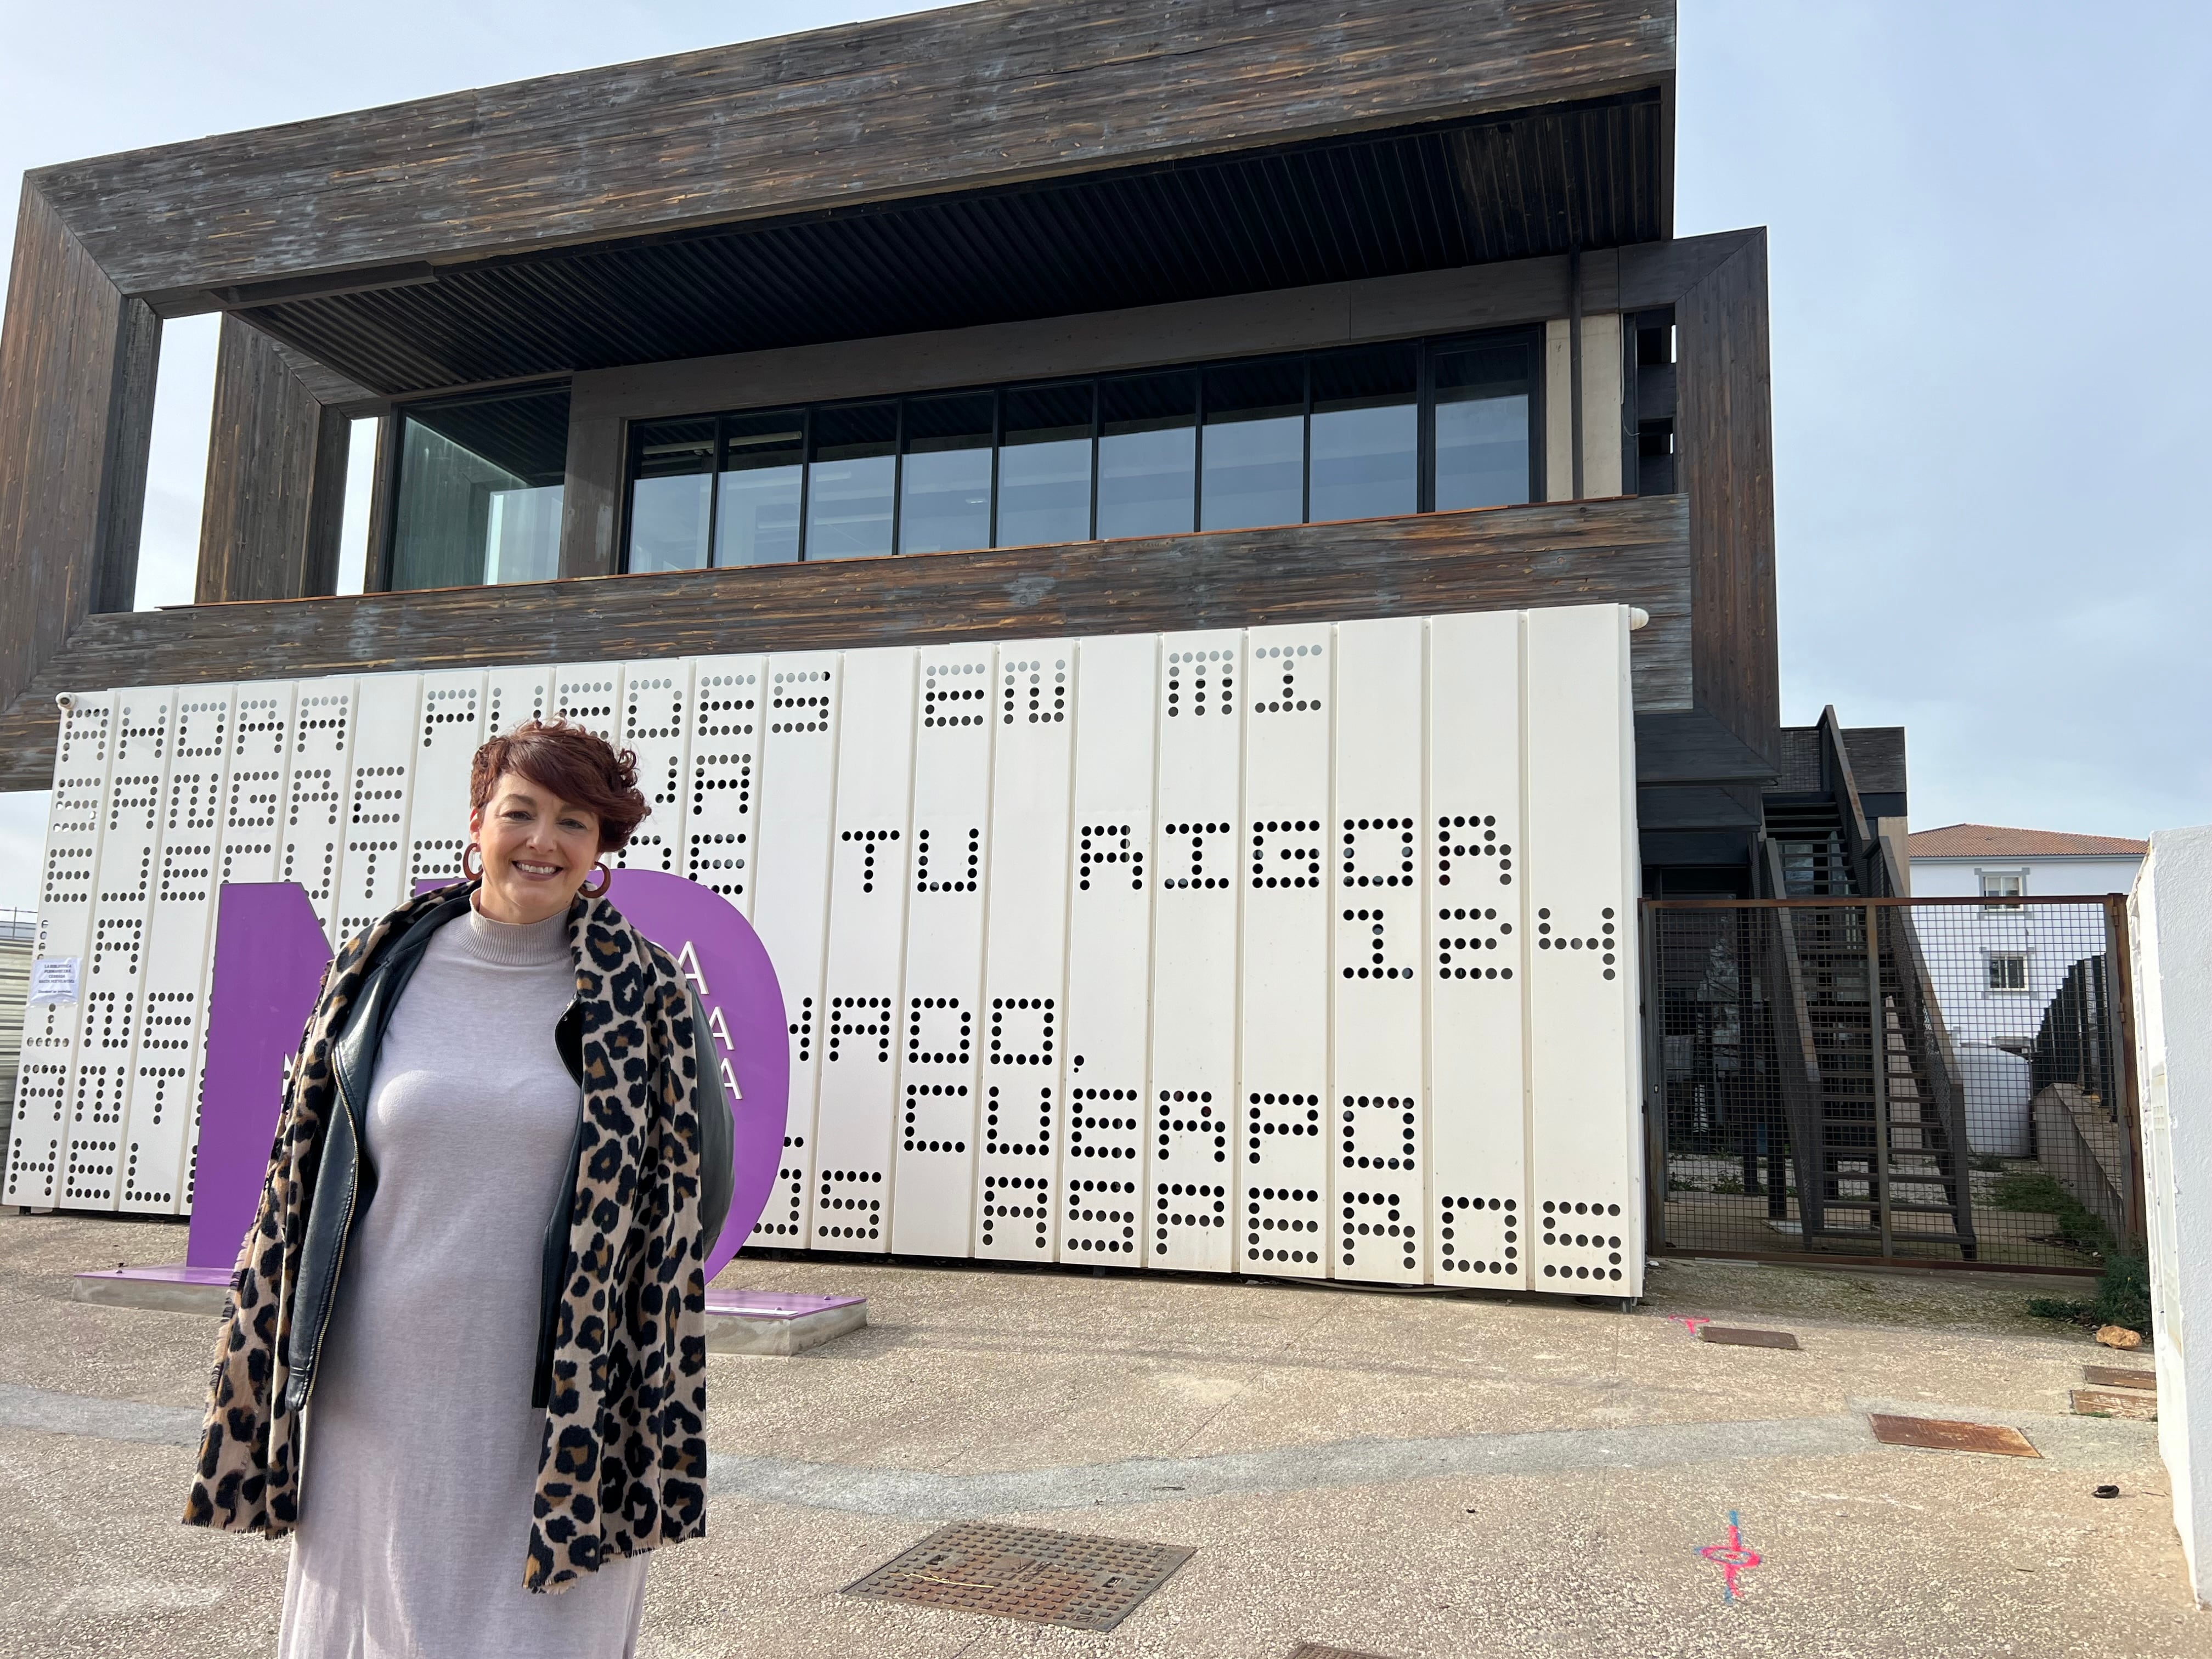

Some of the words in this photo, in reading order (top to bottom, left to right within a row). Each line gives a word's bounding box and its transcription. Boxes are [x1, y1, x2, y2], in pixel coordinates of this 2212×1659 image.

[61, 695, 349, 762] AHORA
[424, 671, 831, 747] PUEDES
[924, 659, 1065, 728] EN
[1167, 644, 1323, 718] MI
[53, 766, 405, 833] SANGRE
[842, 828, 979, 893] TU
[1080, 815, 1511, 891] RIGOR
[1342, 907, 1616, 981] 124
[904, 1084, 1415, 1171] CUERPO
[983, 1175, 1623, 1282] ASPEROS
